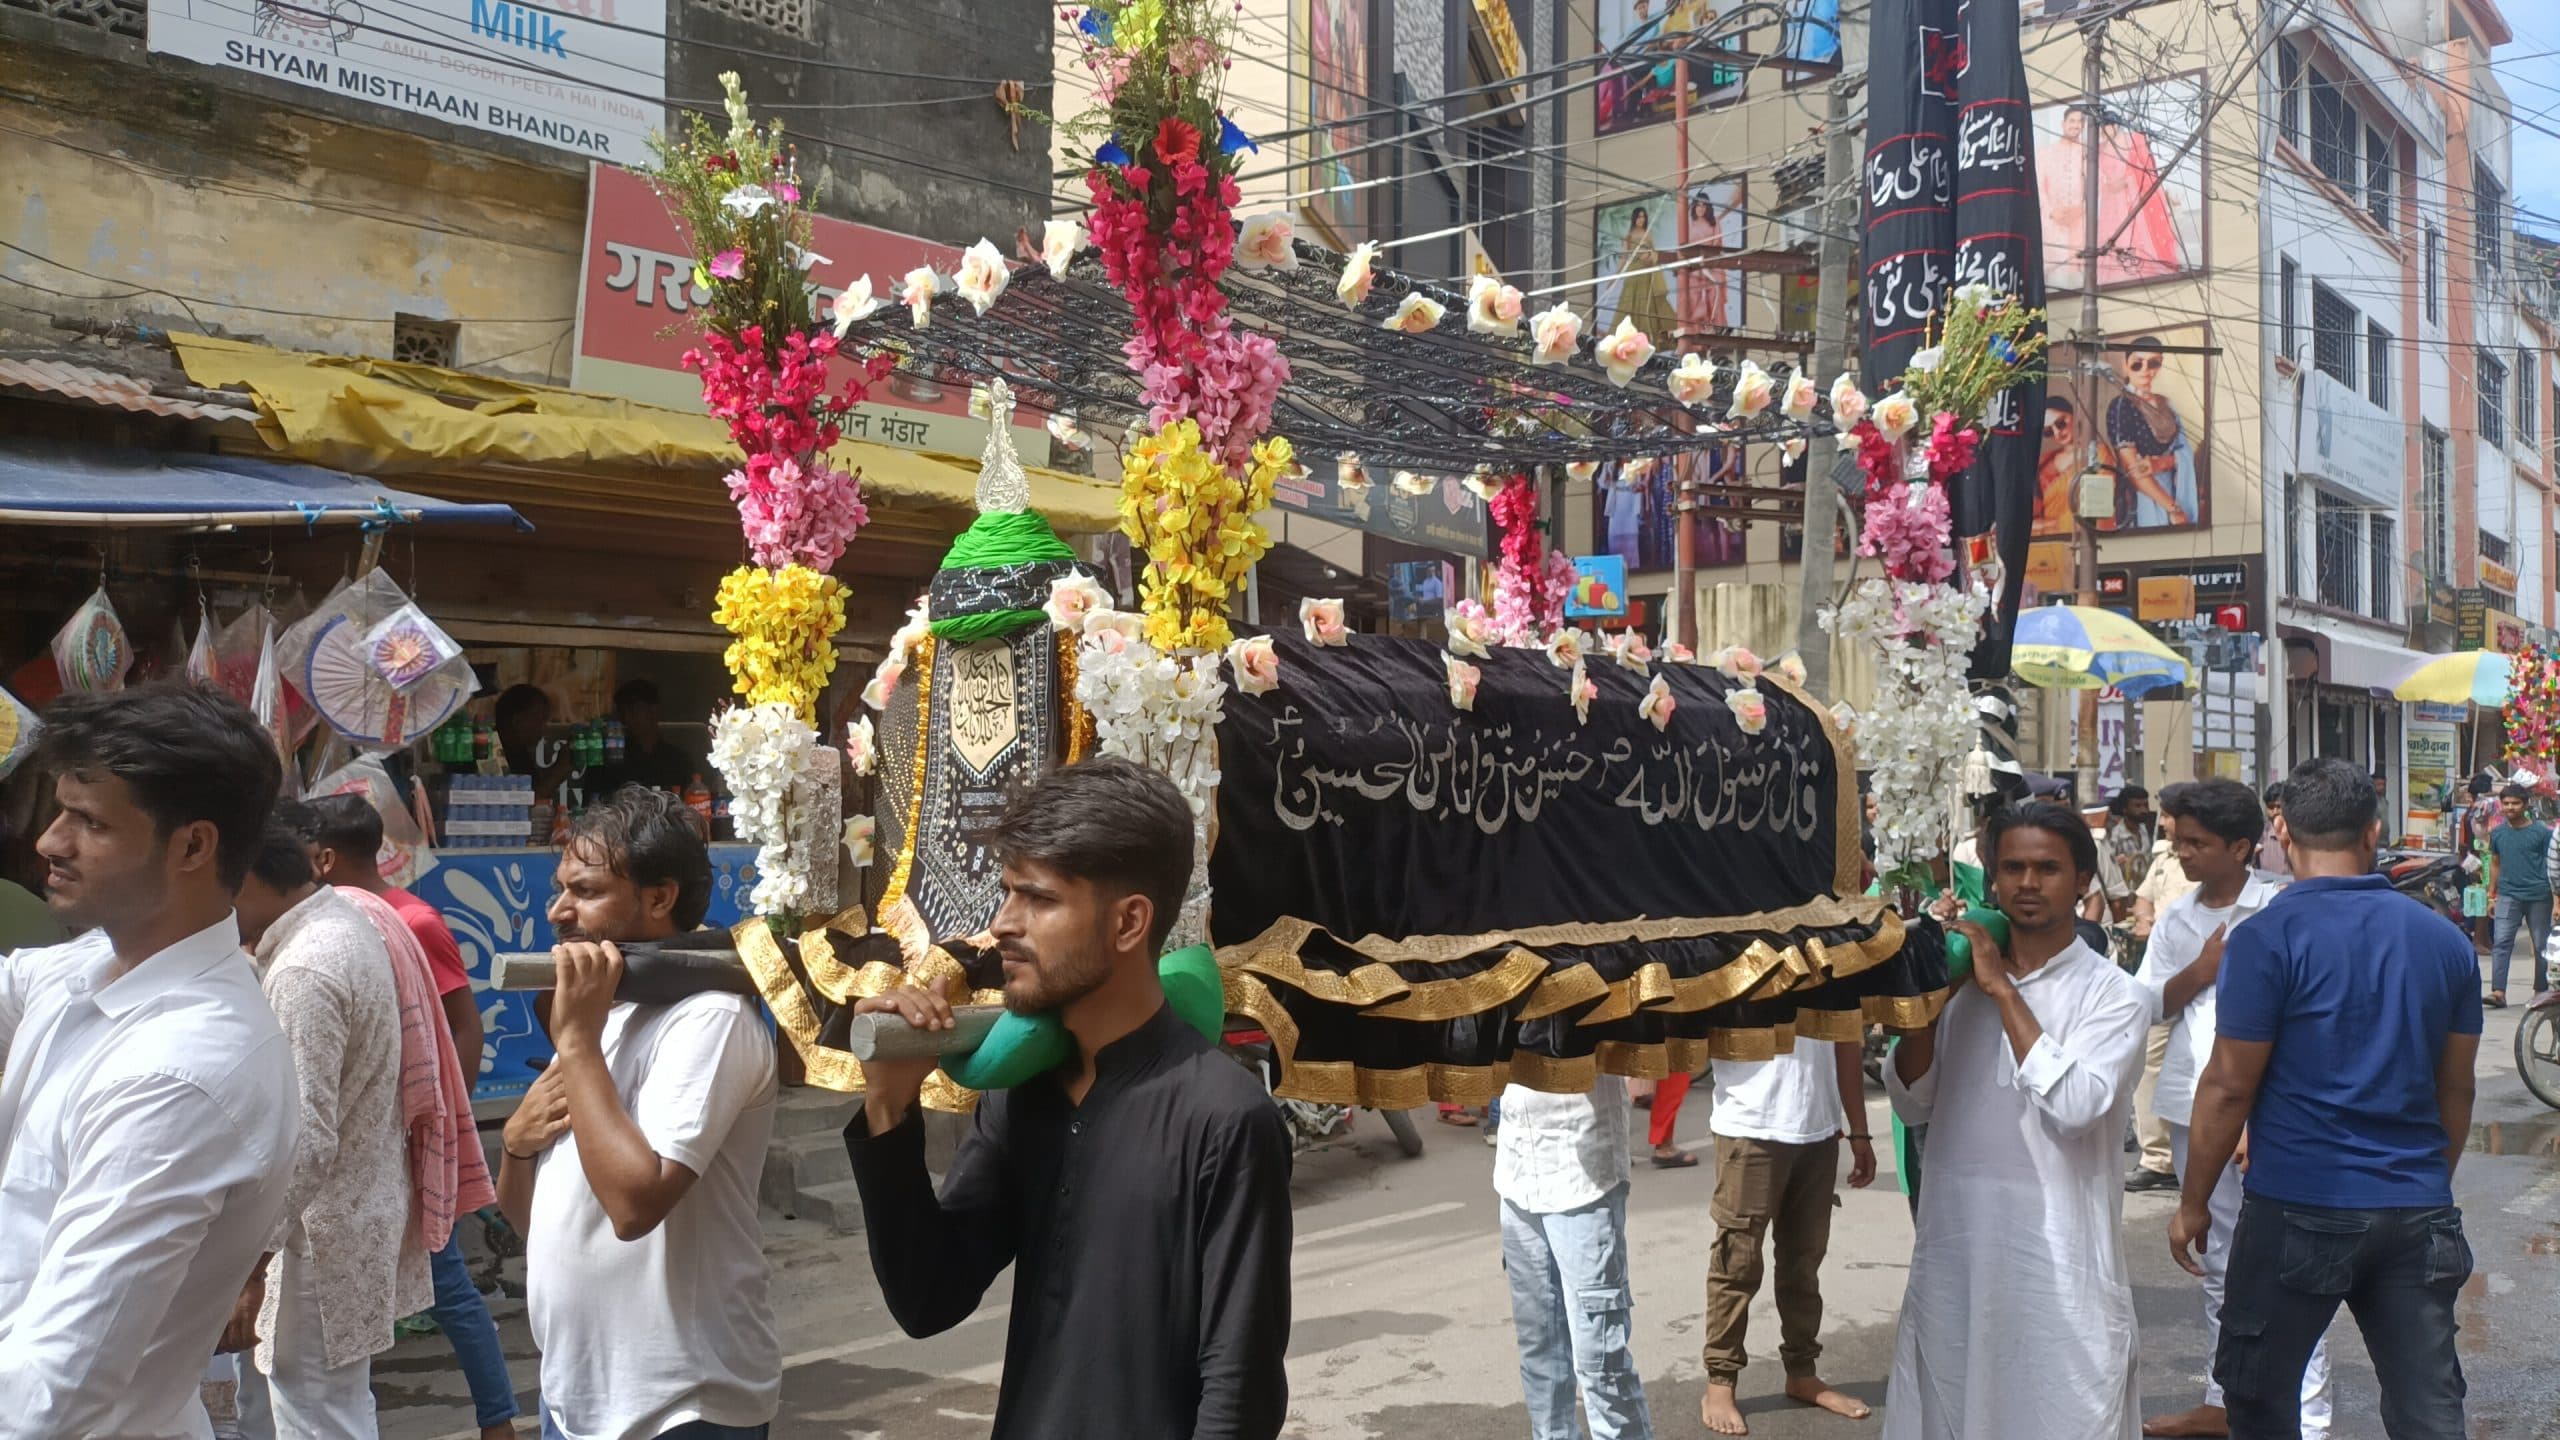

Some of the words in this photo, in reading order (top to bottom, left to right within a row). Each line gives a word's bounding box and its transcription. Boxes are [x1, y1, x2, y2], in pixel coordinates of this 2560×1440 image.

[471, 0, 567, 59] Milk
[225, 40, 328, 84] SHYAM
[338, 67, 479, 122] MISTHAAN
[488, 105, 611, 154] BHANDAR
[382, 40, 433, 65] AMUL
[441, 54, 505, 85] DOODH
[512, 72, 564, 100] PEETA
[570, 89, 597, 110] HAI
[602, 101, 645, 122] INDIA
[880, 411, 930, 446] भंडार
